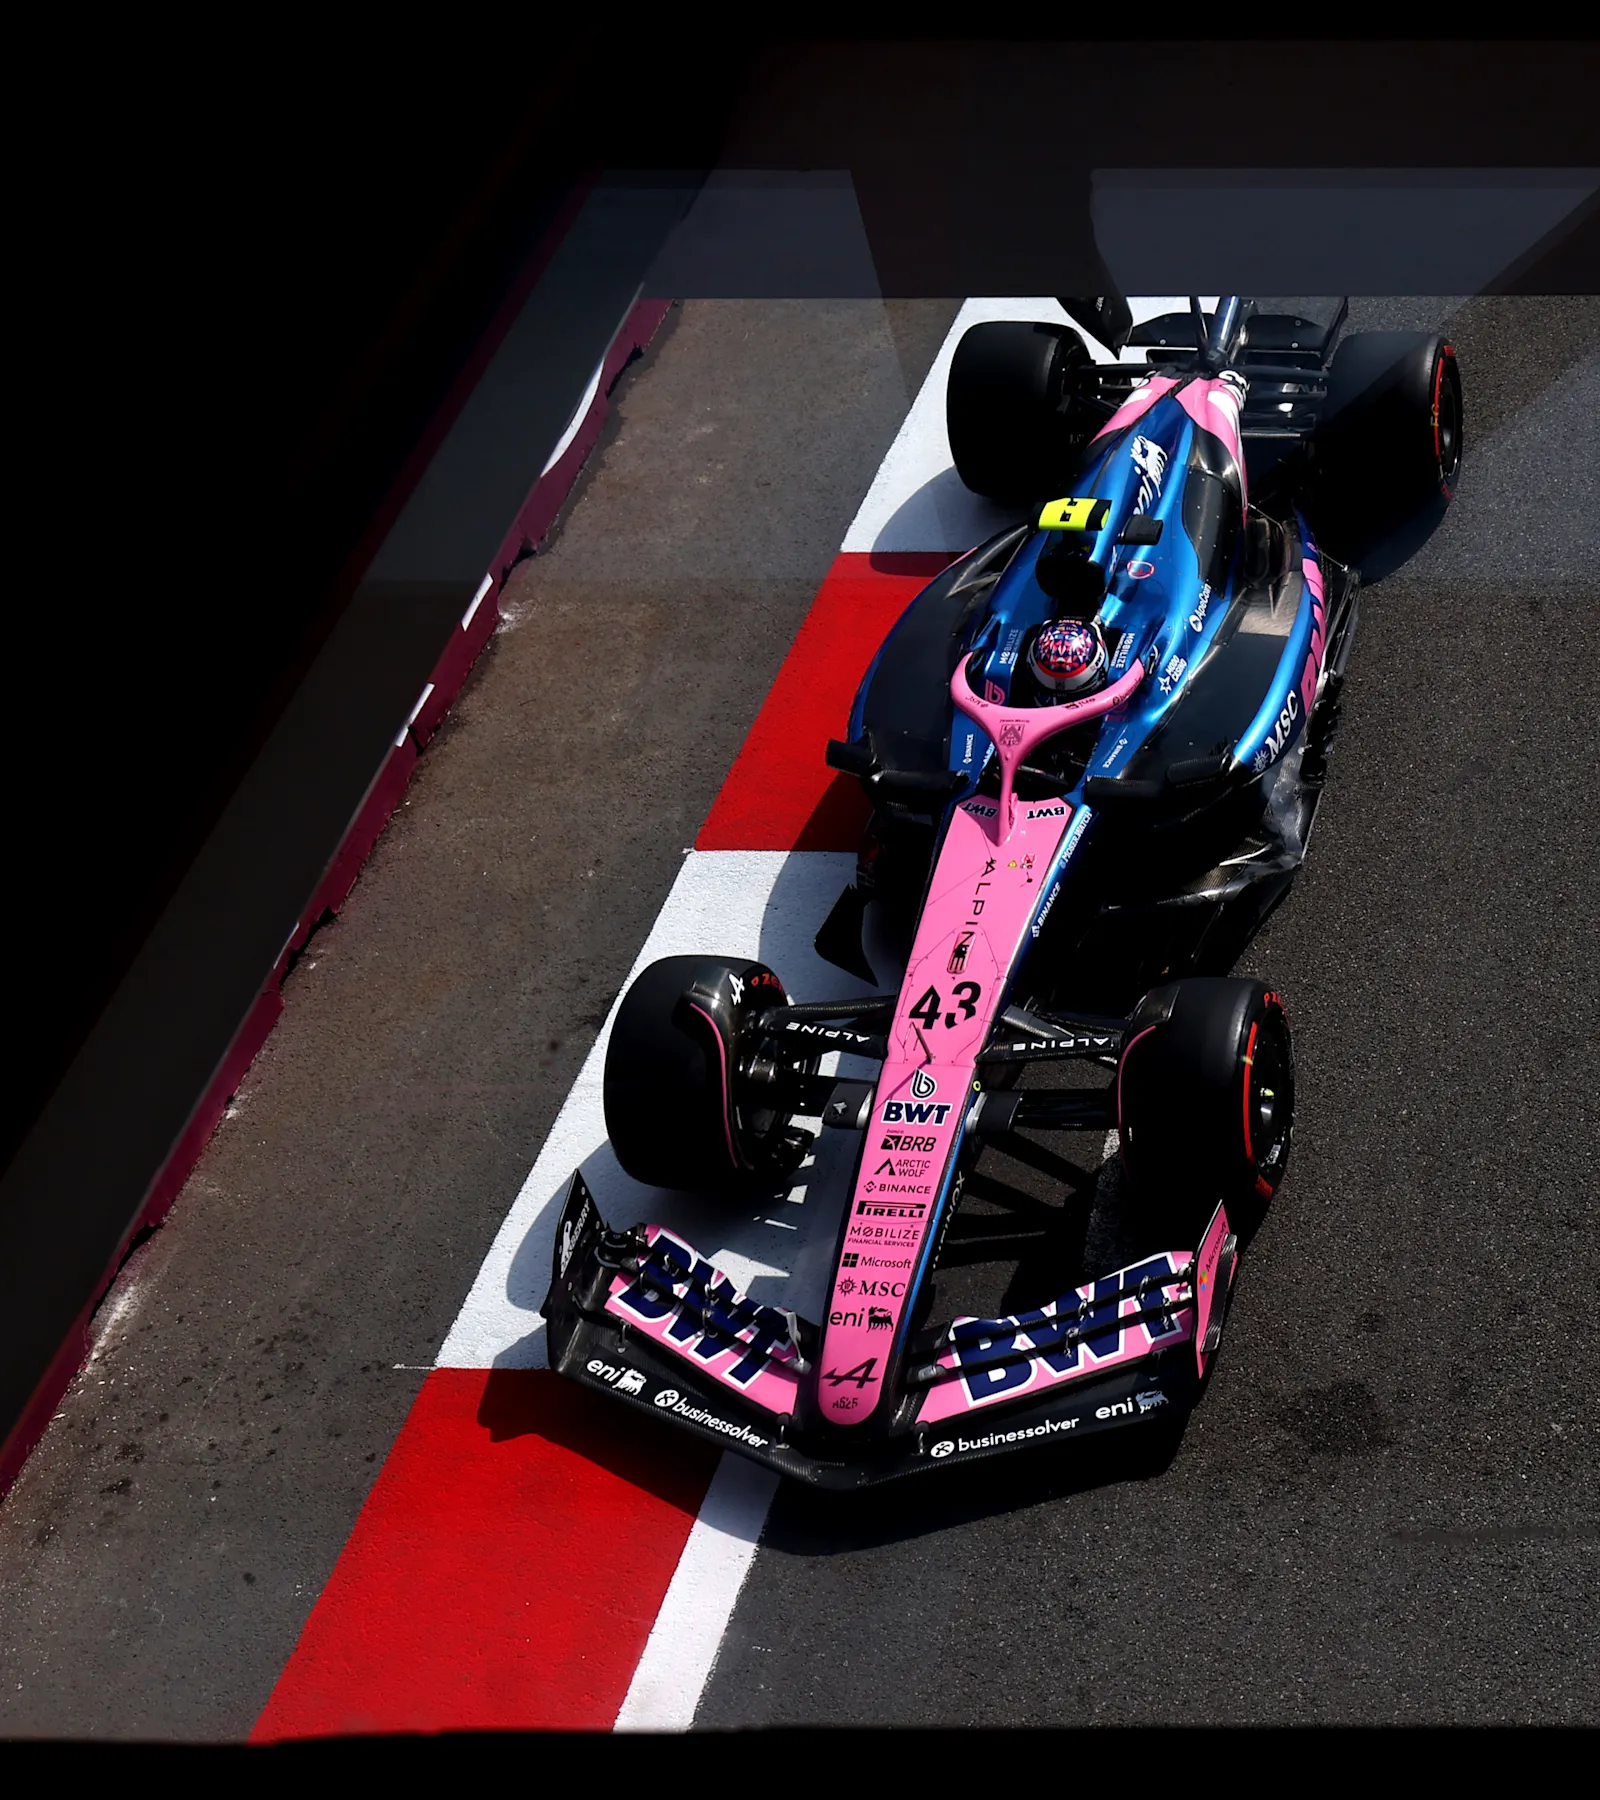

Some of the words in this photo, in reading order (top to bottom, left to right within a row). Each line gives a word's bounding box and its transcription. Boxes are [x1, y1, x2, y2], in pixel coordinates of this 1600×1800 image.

[1264, 690, 1299, 764] MSC
[1102, 744, 1123, 769] BINANCE
[961, 802, 998, 818] BWT
[1027, 807, 1065, 819] BWT
[1037, 882, 1061, 927] BINANCE
[949, 858, 996, 973] ALPINE
[909, 981, 981, 1030] 43
[786, 1022, 870, 1043] ALPINE
[1012, 1036, 1110, 1051] ALPINE
[881, 1100, 952, 1126] BWT
[900, 1136, 936, 1152] BRB
[895, 1159, 931, 1168] ARCTIC
[898, 1168, 926, 1177] WOLF
[879, 1184, 931, 1194] BINANCE
[856, 1201, 927, 1218] PIRELLI
[847, 1238, 882, 1246] FINANCIAL
[884, 1240, 915, 1248] SERVICES
[850, 1226, 920, 1240] MØBILIZE
[1206, 1221, 1226, 1272] Microsoft
[860, 1256, 912, 1269] Microsoft
[858, 1280, 906, 1297] MSC
[610, 1228, 797, 1391] BWT
[829, 1308, 865, 1327] eni
[949, 1251, 1183, 1408] BWT
[587, 1359, 625, 1382] eni
[1095, 1398, 1134, 1419] eni
[672, 1398, 769, 1448] businessolver
[958, 1418, 1080, 1452] businessolver
